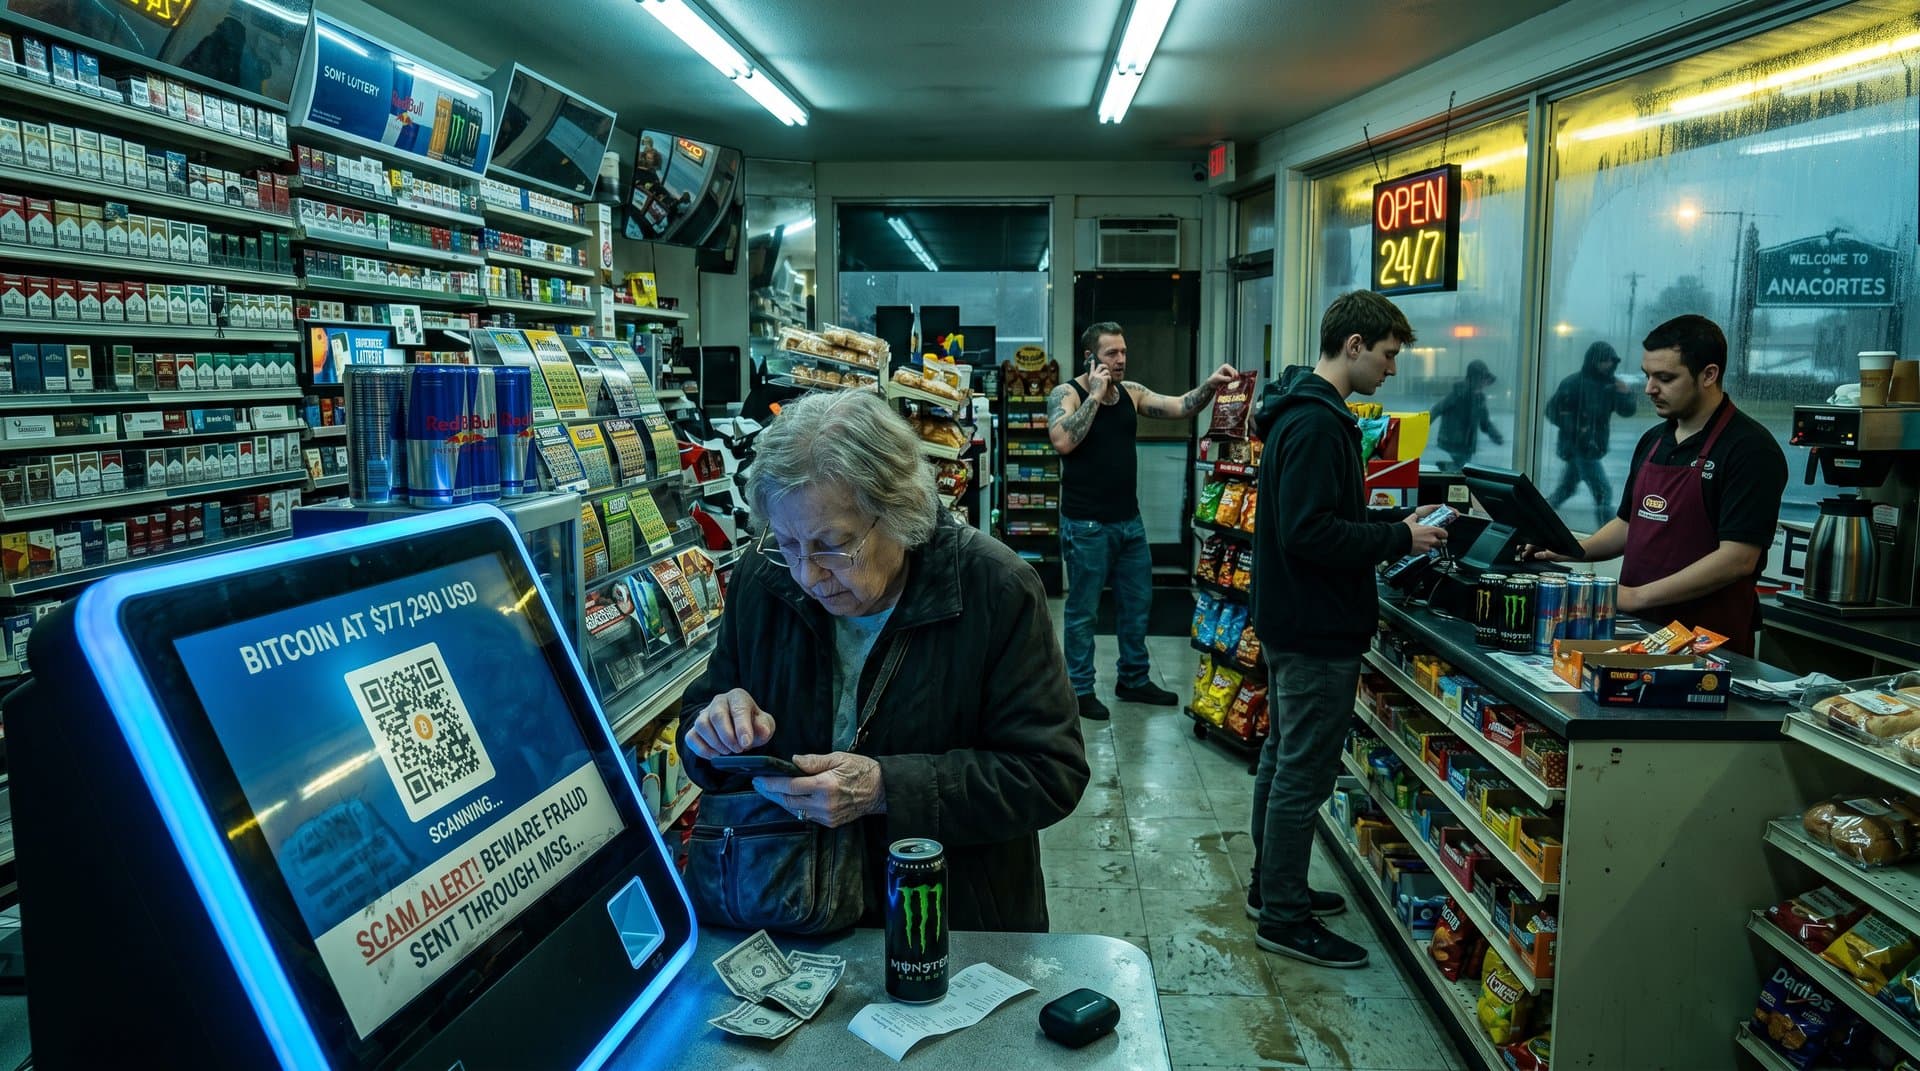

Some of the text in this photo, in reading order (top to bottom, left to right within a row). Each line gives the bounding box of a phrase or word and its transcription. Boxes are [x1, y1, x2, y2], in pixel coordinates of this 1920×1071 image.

[1377, 176, 1444, 232] OPEN
[1380, 229, 1441, 287] 24/7
[1789, 253, 1869, 265] WELCOME TO
[1766, 278, 1886, 296] ANACORTES
[239, 581, 478, 675] BITCOIN AT $77,290 USD
[428, 795, 503, 843] SCANNING...
[356, 786, 588, 957] SCAM ALERT! BEWARE FRAUD
[409, 836, 584, 968] SENT THROUGH MSG...
[1771, 967, 1835, 1012] Doritos
